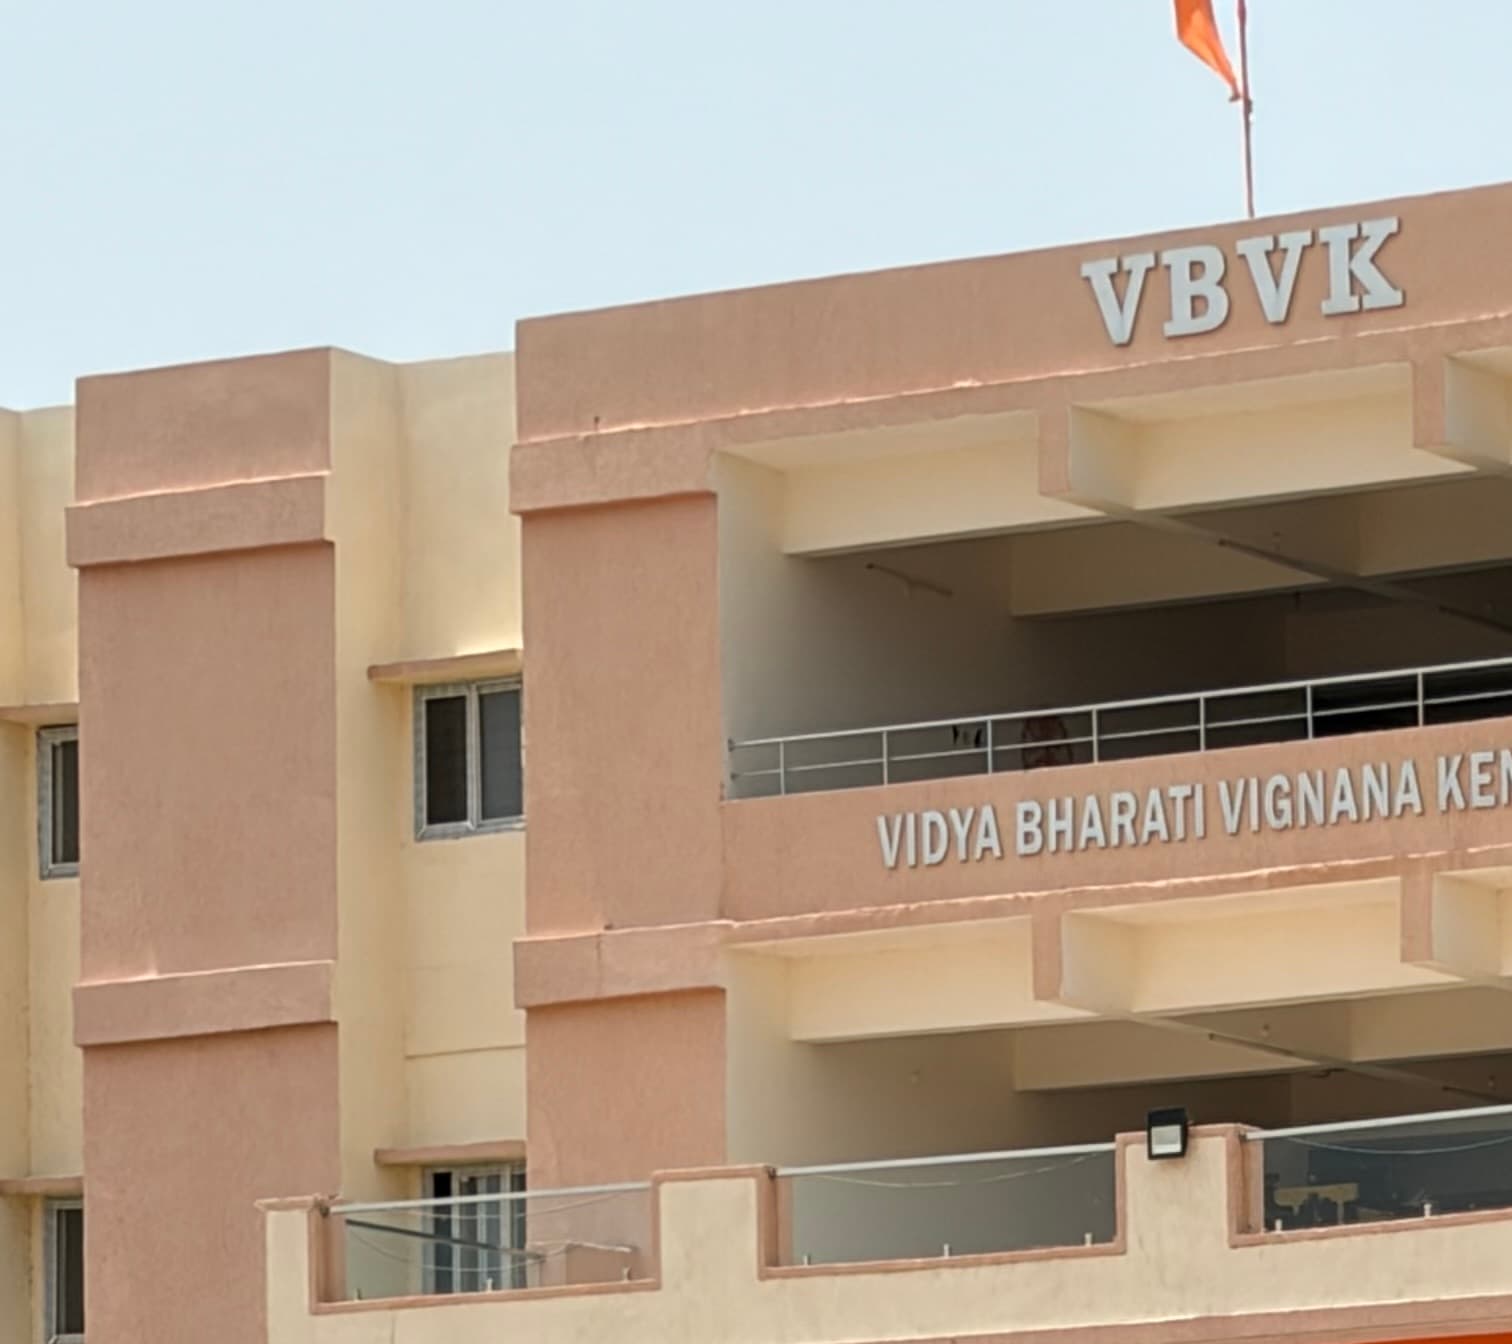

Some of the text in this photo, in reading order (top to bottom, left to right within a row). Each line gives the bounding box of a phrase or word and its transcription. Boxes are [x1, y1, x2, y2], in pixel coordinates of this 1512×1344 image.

[1081, 216, 1405, 346] VBVK
[877, 804, 1002, 869] VIDYA
[1016, 783, 1206, 856] BHARATI
[1218, 758, 1424, 835] VIGNANA
